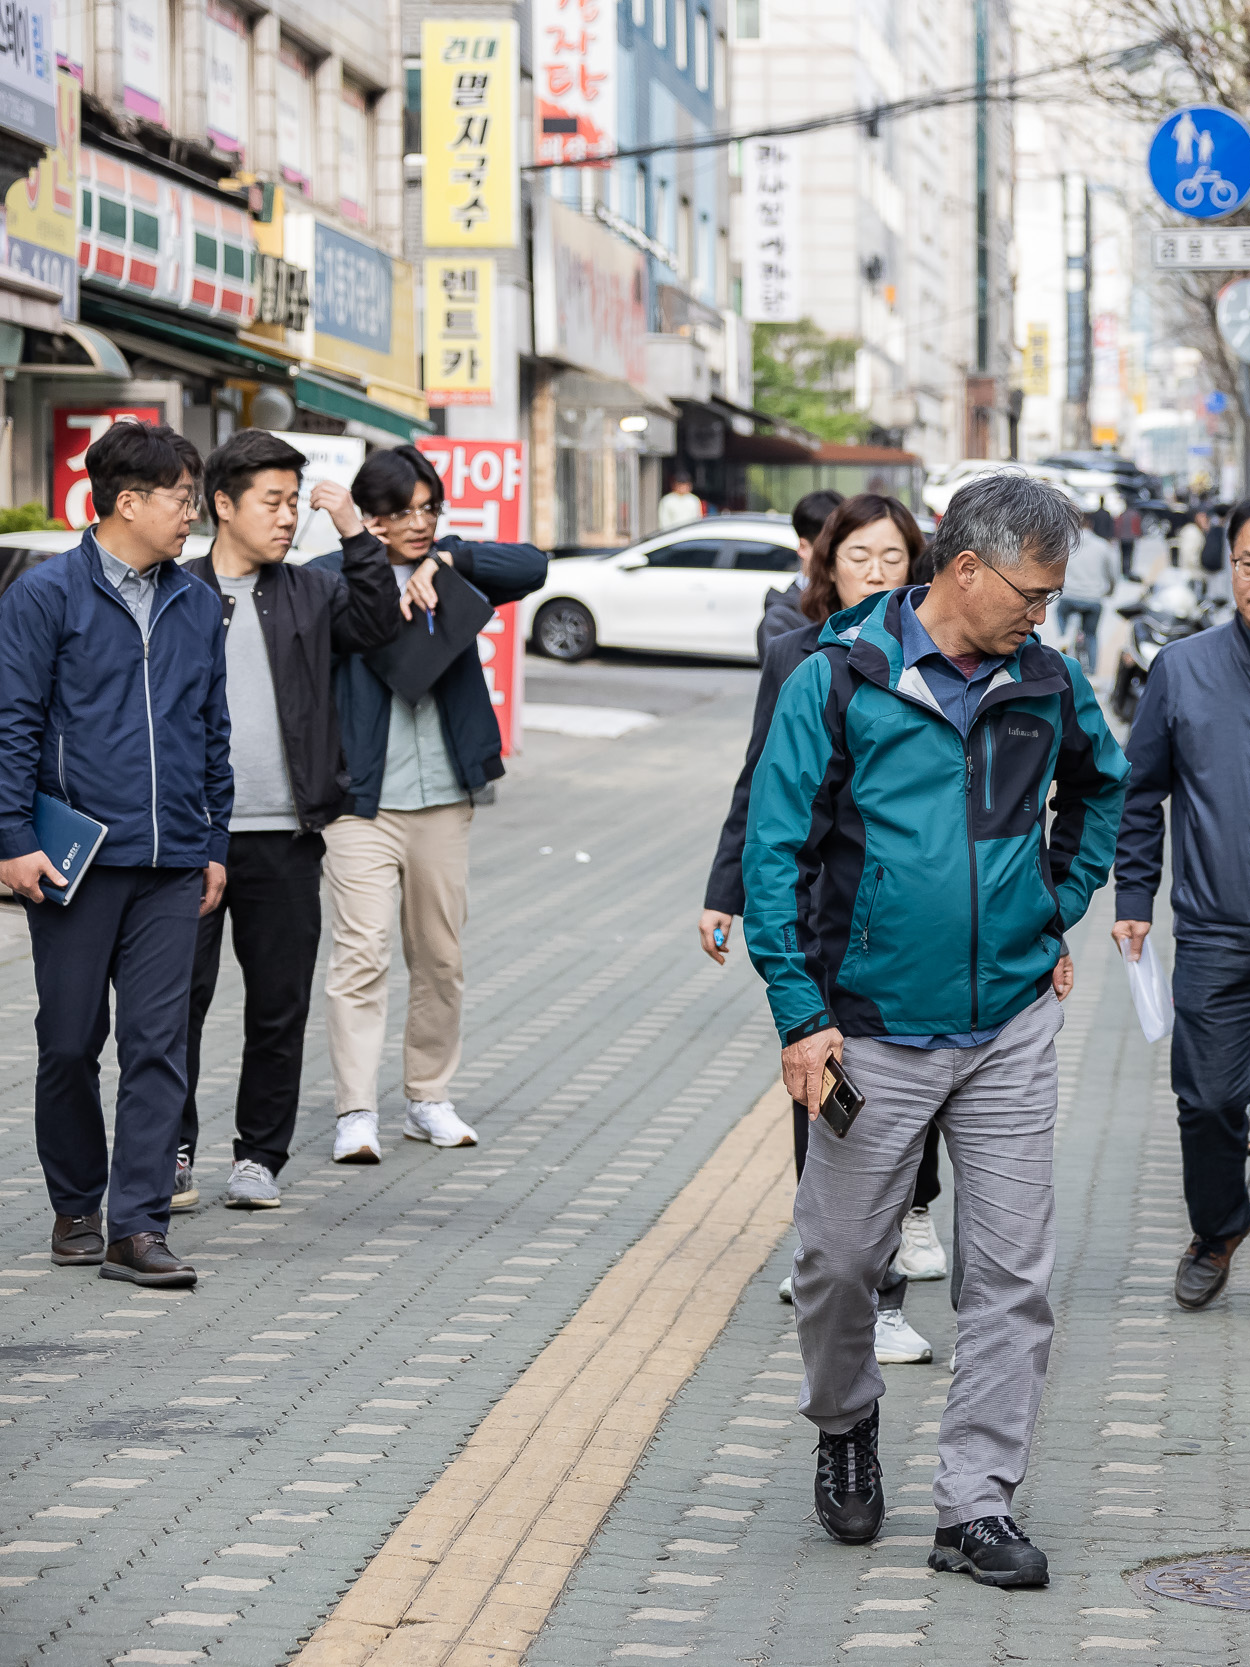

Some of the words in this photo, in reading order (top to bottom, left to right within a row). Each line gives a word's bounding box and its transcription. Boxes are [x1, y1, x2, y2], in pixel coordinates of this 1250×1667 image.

[443, 37, 498, 63] 건대
[449, 72, 491, 231] 멸치국수
[440, 268, 479, 379] 렌트카
